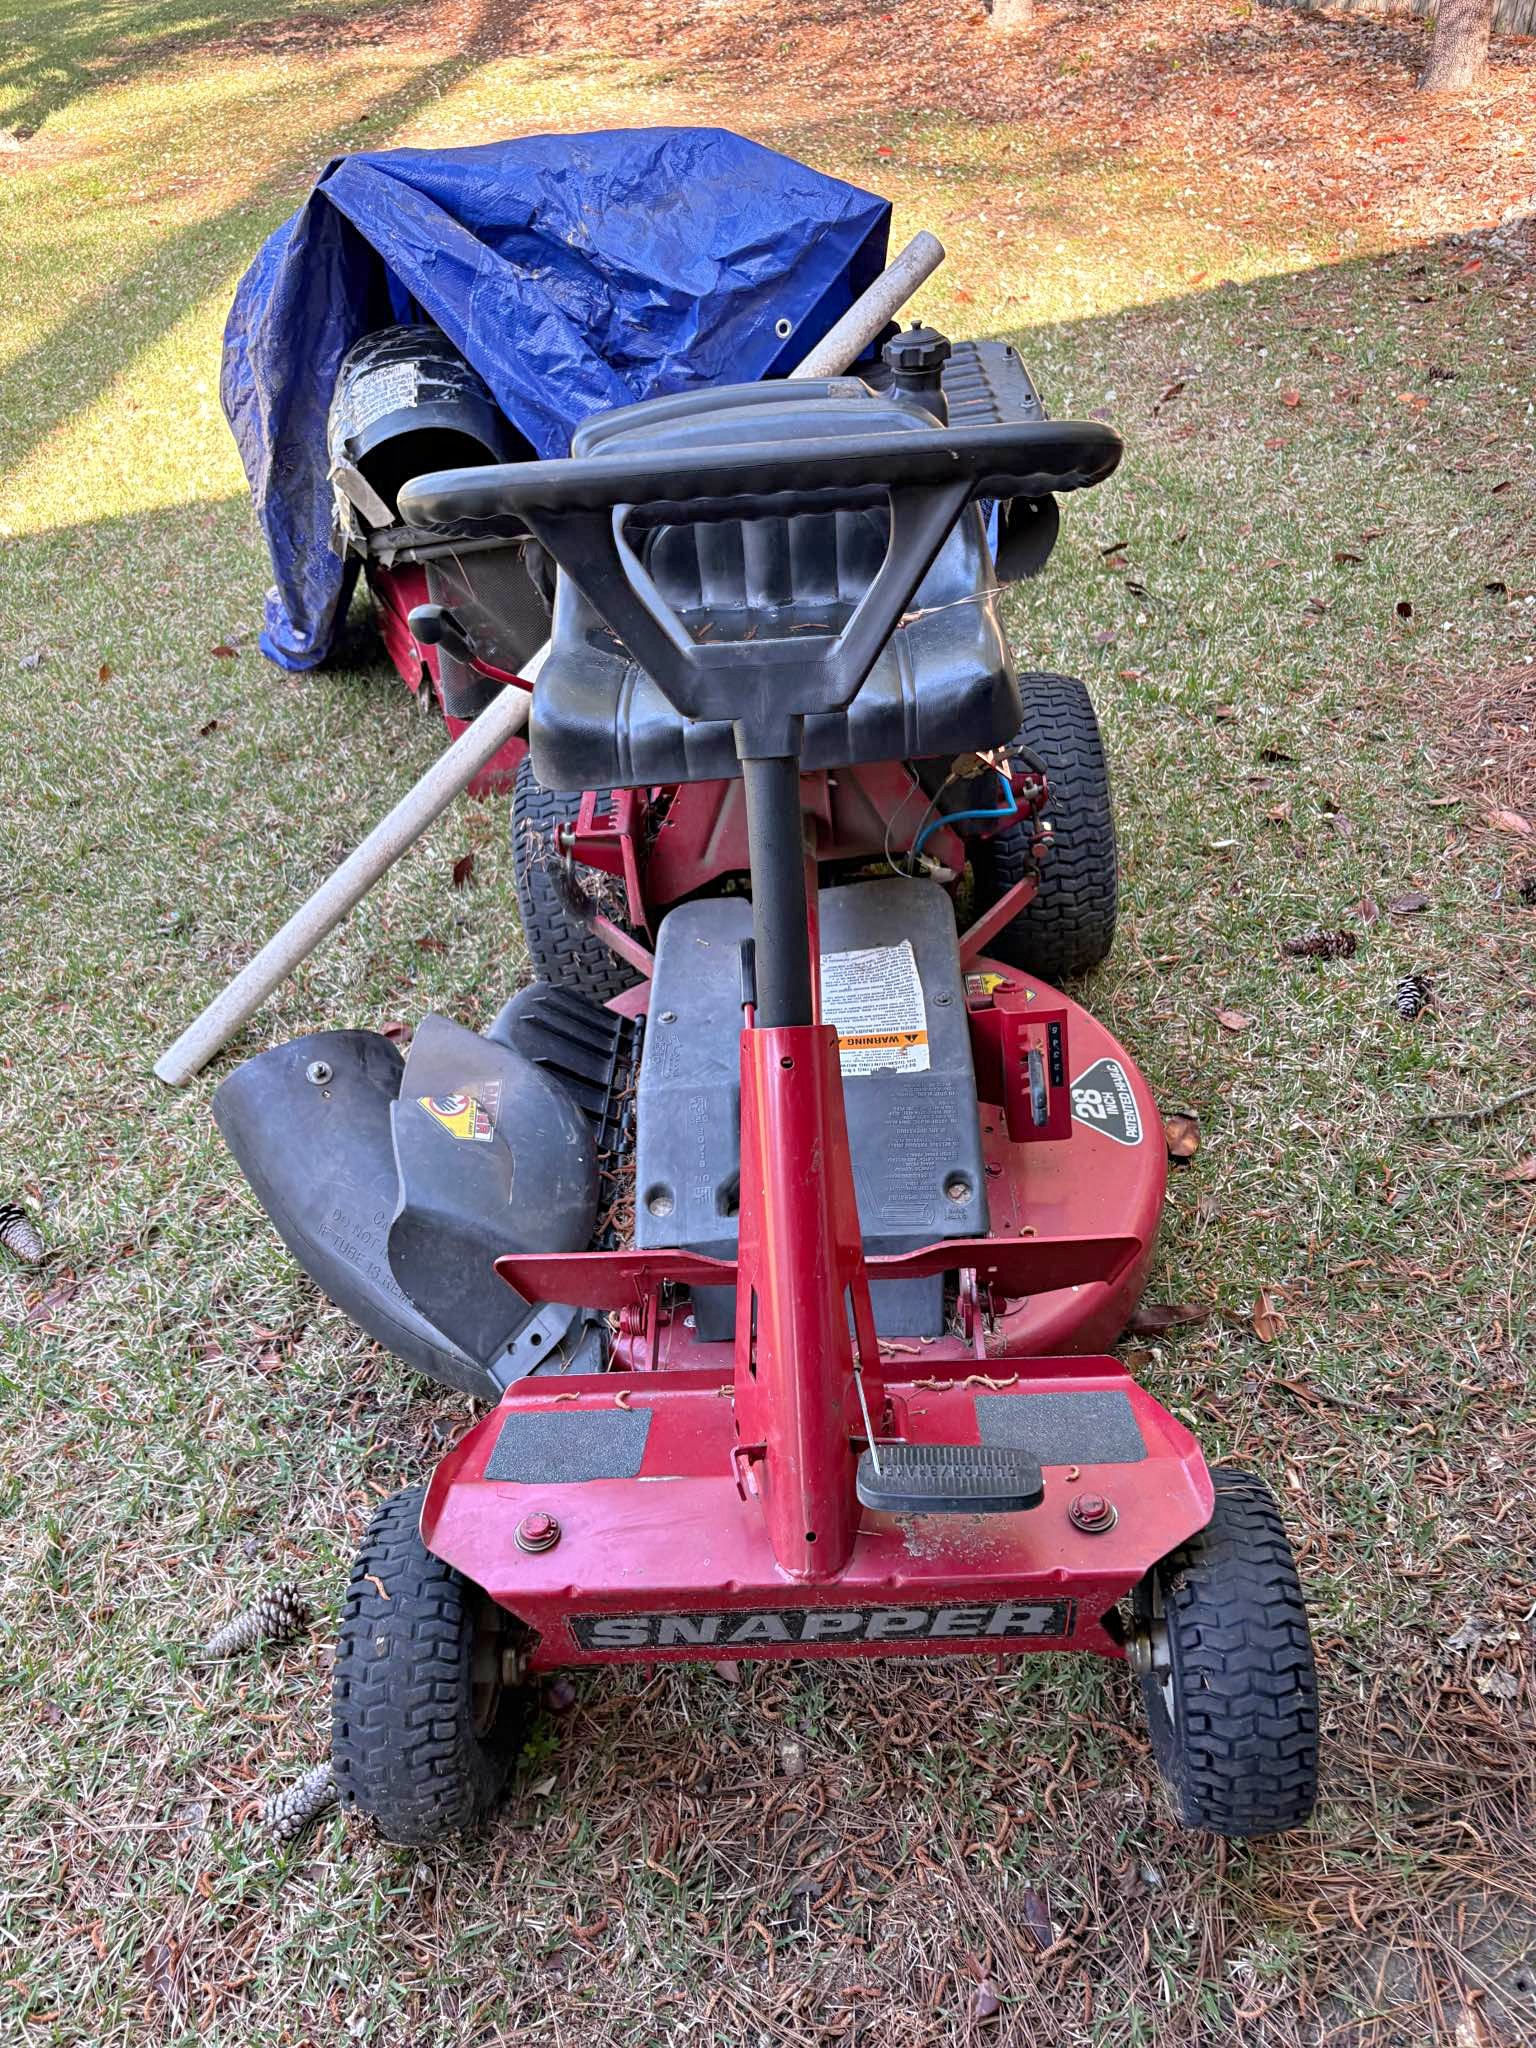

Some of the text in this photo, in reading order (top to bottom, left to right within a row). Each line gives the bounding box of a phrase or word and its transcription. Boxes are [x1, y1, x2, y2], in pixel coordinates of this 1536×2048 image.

[847, 1035, 899, 1046] WARNING
[1072, 1089, 1107, 1120] 28
[1101, 1091, 1118, 1115] INCH
[1119, 1092, 1138, 1138] PATENTED
[333, 1235, 366, 1266] TUBE
[591, 1606, 1056, 1646] SNAPPER
